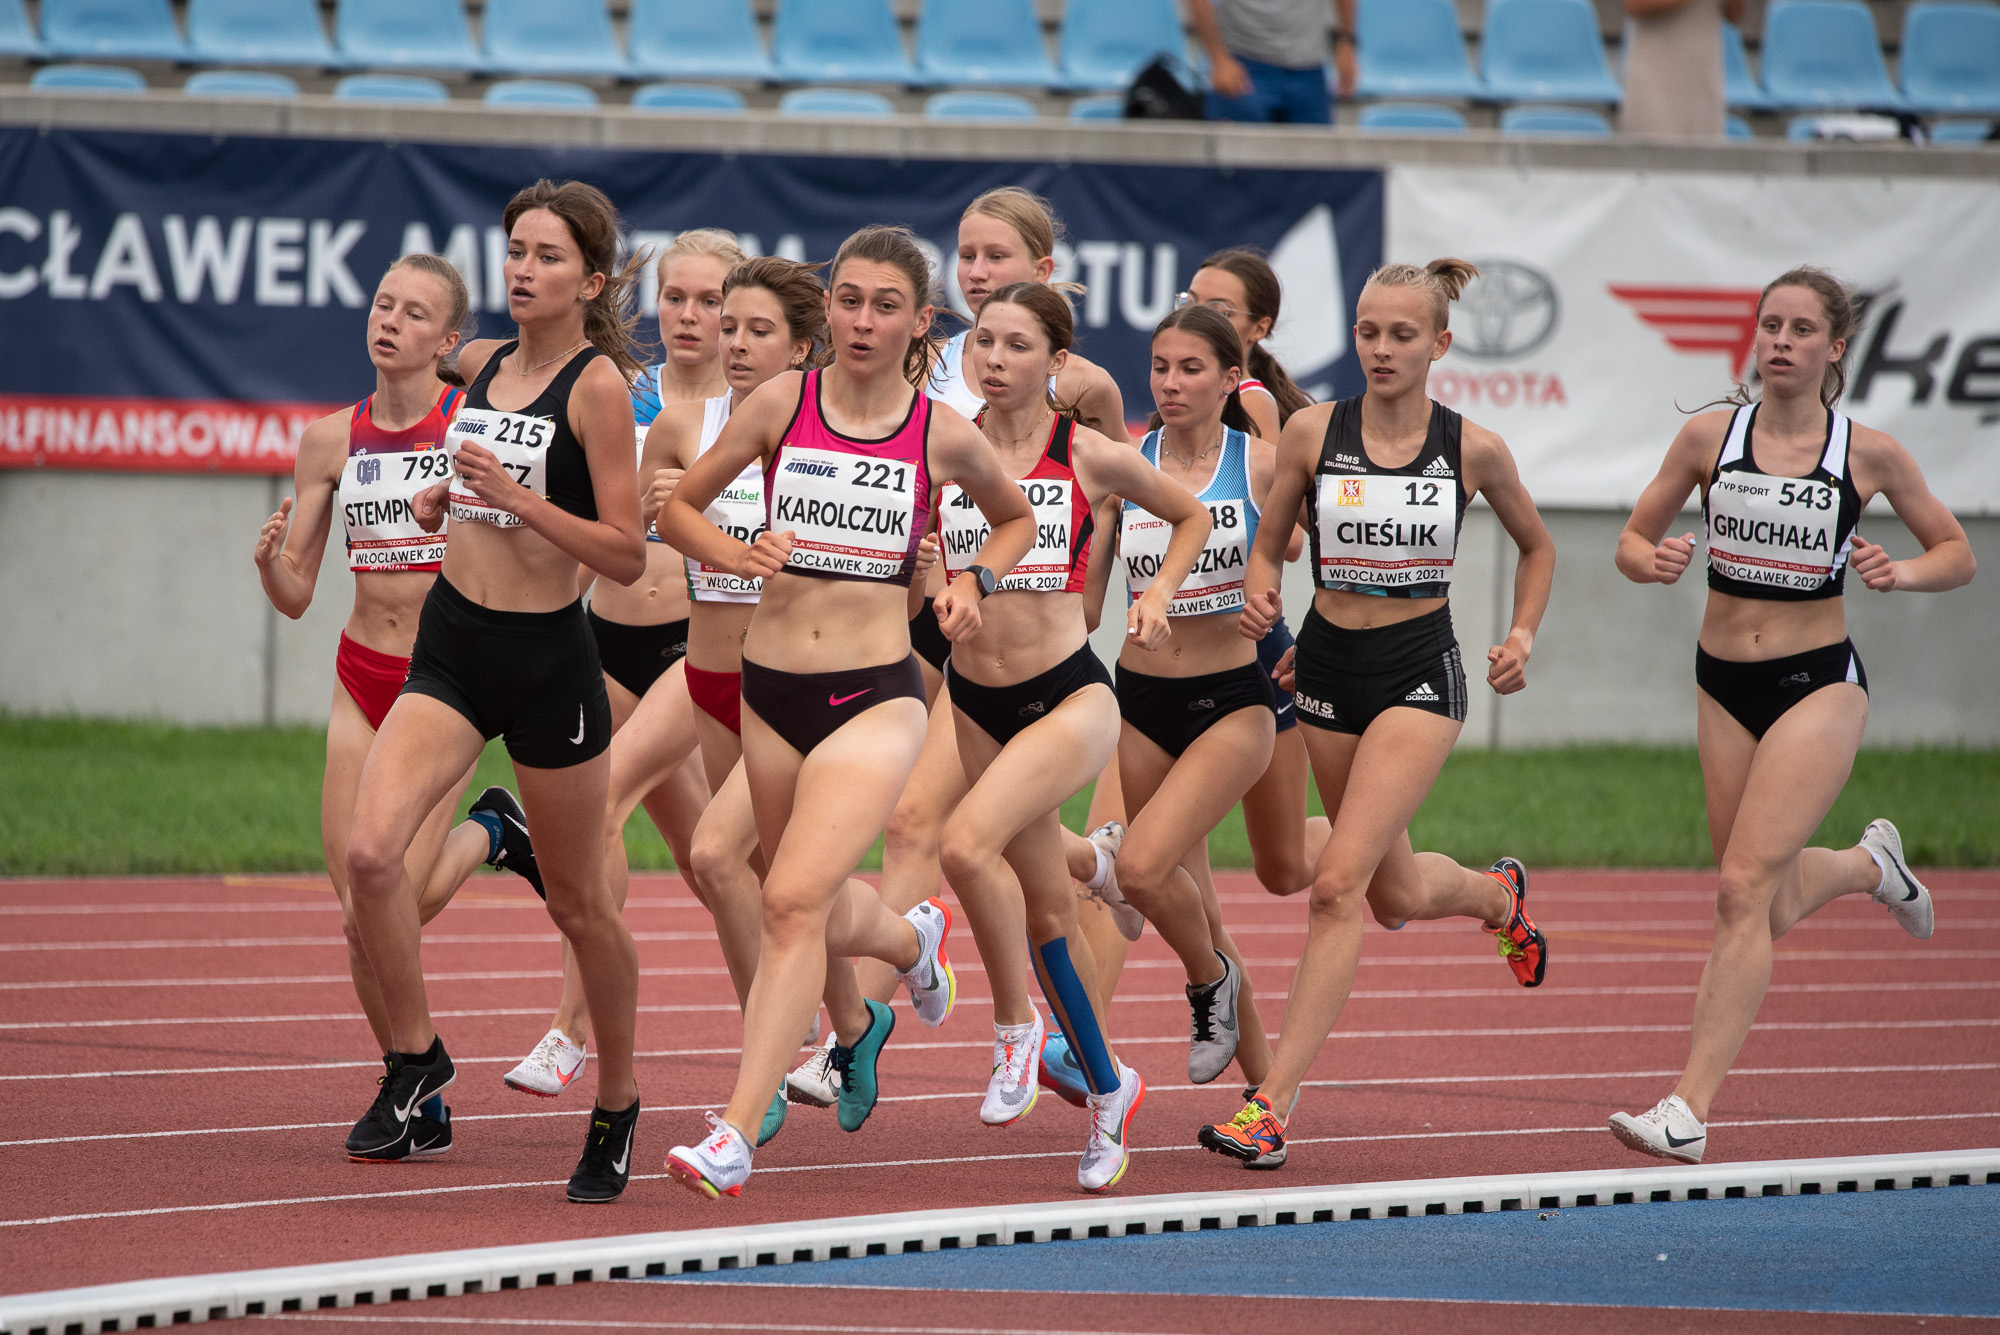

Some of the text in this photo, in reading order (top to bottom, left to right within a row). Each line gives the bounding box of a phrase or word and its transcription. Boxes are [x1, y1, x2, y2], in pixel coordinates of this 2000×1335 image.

[494, 418, 545, 448] 215
[402, 453, 449, 480] 793
[1335, 453, 1360, 464] SMS
[784, 462, 839, 478] 4MOVE
[851, 461, 906, 493] 221
[1422, 468, 1455, 477] adidas
[718, 488, 760, 501] TALbet
[1019, 483, 1064, 507] 02
[1404, 482, 1439, 506] 12
[1717, 481, 1770, 497] TVP SPORT
[1778, 482, 1833, 511] 543
[1340, 496, 1362, 505] PZLA
[345, 498, 417, 527] STEMPN
[504, 513, 528, 526] 20
[776, 494, 907, 537] KAROLCZUK
[1336, 518, 1439, 547] CIEŚLIK
[1713, 514, 1829, 552] GRUCHAŁA
[355, 546, 447, 565] WŁOCŁAWEK 20
[806, 542, 860, 555] MISTRZOSTWA
[860, 550, 887, 558] POLSKI
[787, 552, 897, 576] OCŁAWEK 2021
[1722, 553, 1738, 561] PZLA
[1738, 556, 1788, 569] MISTRZOSTWA
[1788, 564, 1813, 573] POLSKI
[1036, 576, 1062, 589] 2021
[1329, 568, 1444, 584] WŁOCŁAWEK 2021
[1715, 560, 1823, 588] WŁOCŁAWEK 2021
[1176, 589, 1208, 598] RZOSTWA
[1207, 585, 1230, 593] POLSKI
[1215, 591, 1242, 608] 2021
[1295, 691, 1334, 714] SMS
[1405, 693, 1439, 701] adidas
